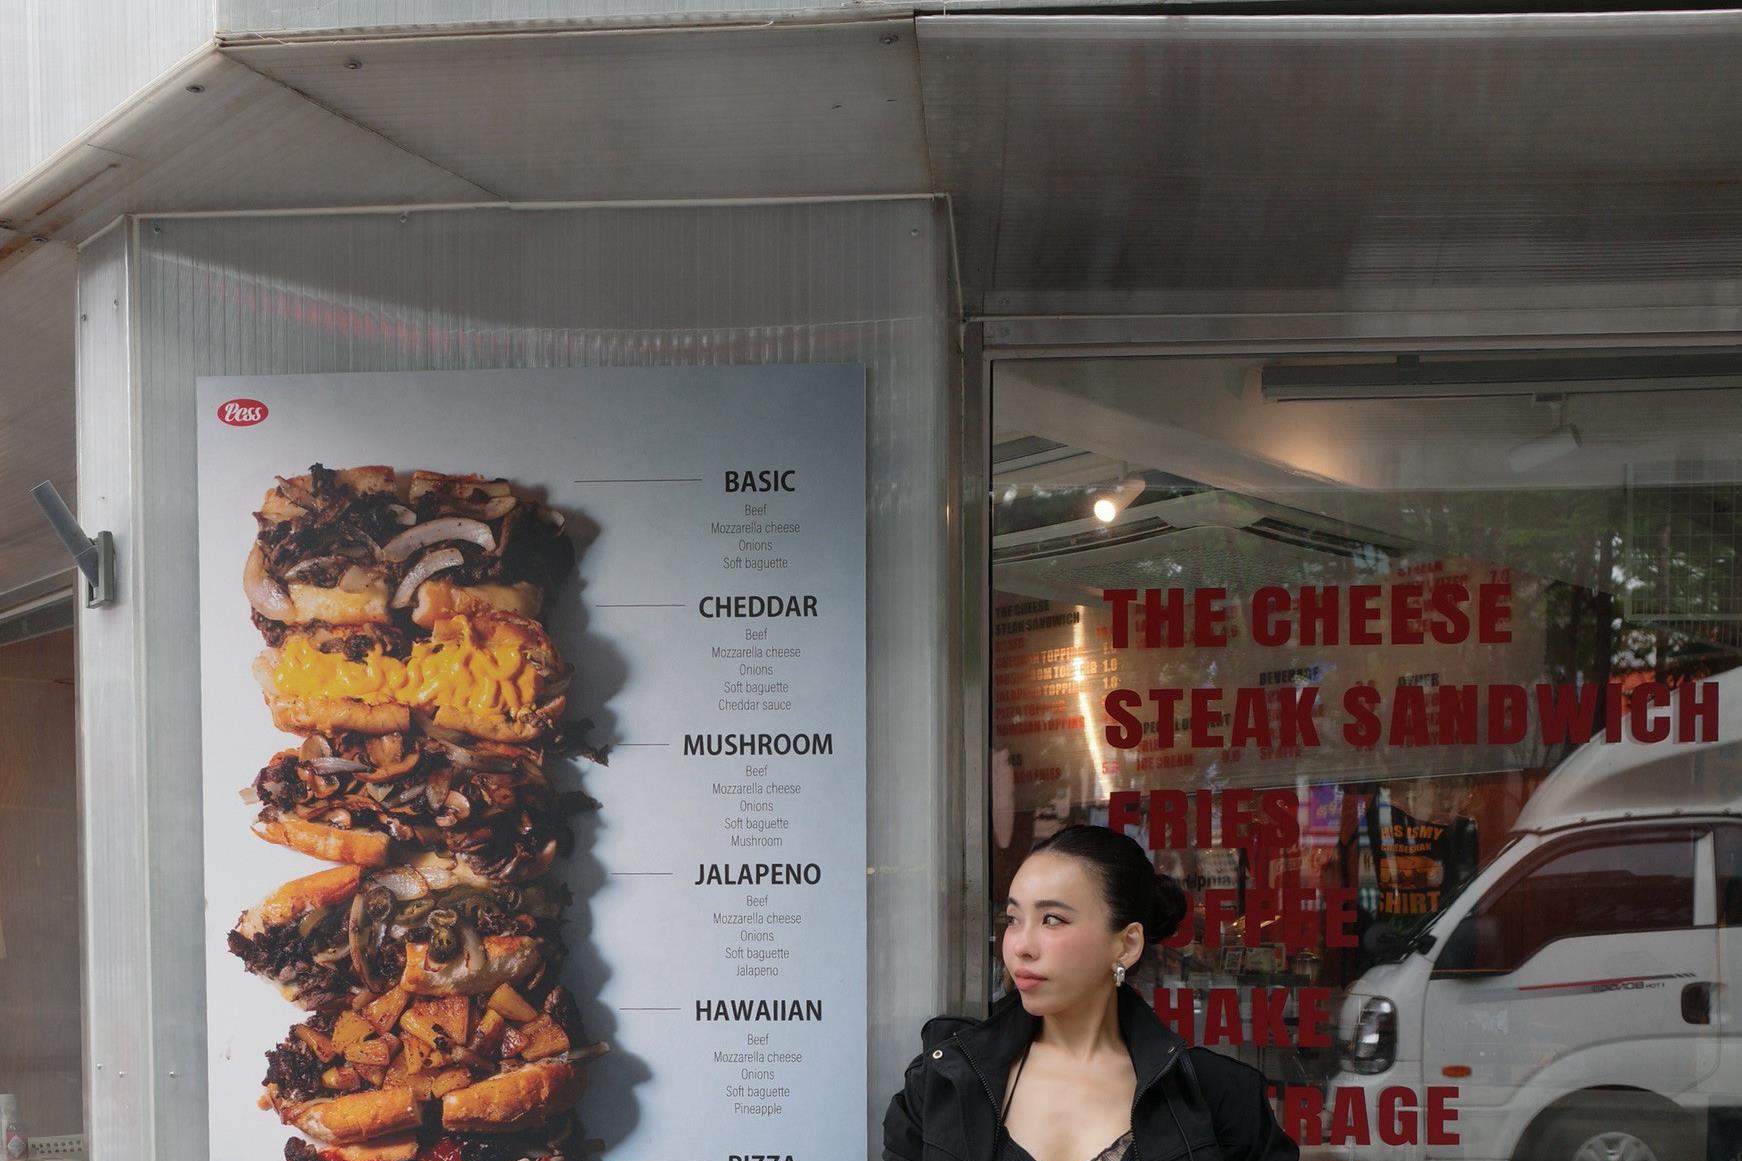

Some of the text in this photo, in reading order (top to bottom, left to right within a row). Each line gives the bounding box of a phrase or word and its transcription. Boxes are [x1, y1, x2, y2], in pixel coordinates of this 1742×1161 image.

[725, 470, 796, 492] BASIC
[744, 504, 767, 516] Beef
[711, 521, 800, 534] Mozzarella cheese
[738, 539, 773, 551] Onions
[723, 556, 788, 571] Soft baguette
[699, 595, 818, 618] CHEDDAR
[1103, 584, 1512, 649] THE CHEESE
[745, 628, 768, 641] Beef
[711, 646, 801, 658] Mozzarella cheese
[739, 664, 773, 676] Onions
[724, 680, 789, 696] Soft baguette
[718, 698, 792, 711] Cheddar sauce
[1105, 687, 1320, 750] STEAK
[1343, 682, 1720, 746] SANDWICH
[683, 733, 834, 755] MUSHROOM
[745, 765, 768, 777] Beef
[712, 782, 801, 795] Mozzarella cheese
[740, 800, 774, 812] Onions
[724, 817, 789, 831] Soft baguette
[1108, 789, 1299, 849] FRIES
[731, 835, 783, 847] Mushroom
[694, 863, 822, 885] JALAPENO
[746, 895, 768, 907] Beef
[713, 912, 802, 924] Mozzarella cheese
[1160, 888, 1358, 948] OFFEE
[740, 930, 775, 942] Onions
[725, 947, 790, 961] Soft baguette
[736, 965, 779, 978] Jalapeno
[695, 1000, 823, 1021] HAWAIIAN
[1154, 988, 1333, 1047] HAKE
[747, 1033, 769, 1046] Beef
[713, 1051, 802, 1063] Mozzarella cheese
[741, 1068, 775, 1080] Onions
[726, 1086, 790, 1100] Soft baguette
[734, 1103, 782, 1116] Pineapple
[1266, 1086, 1460, 1146] RAGE
